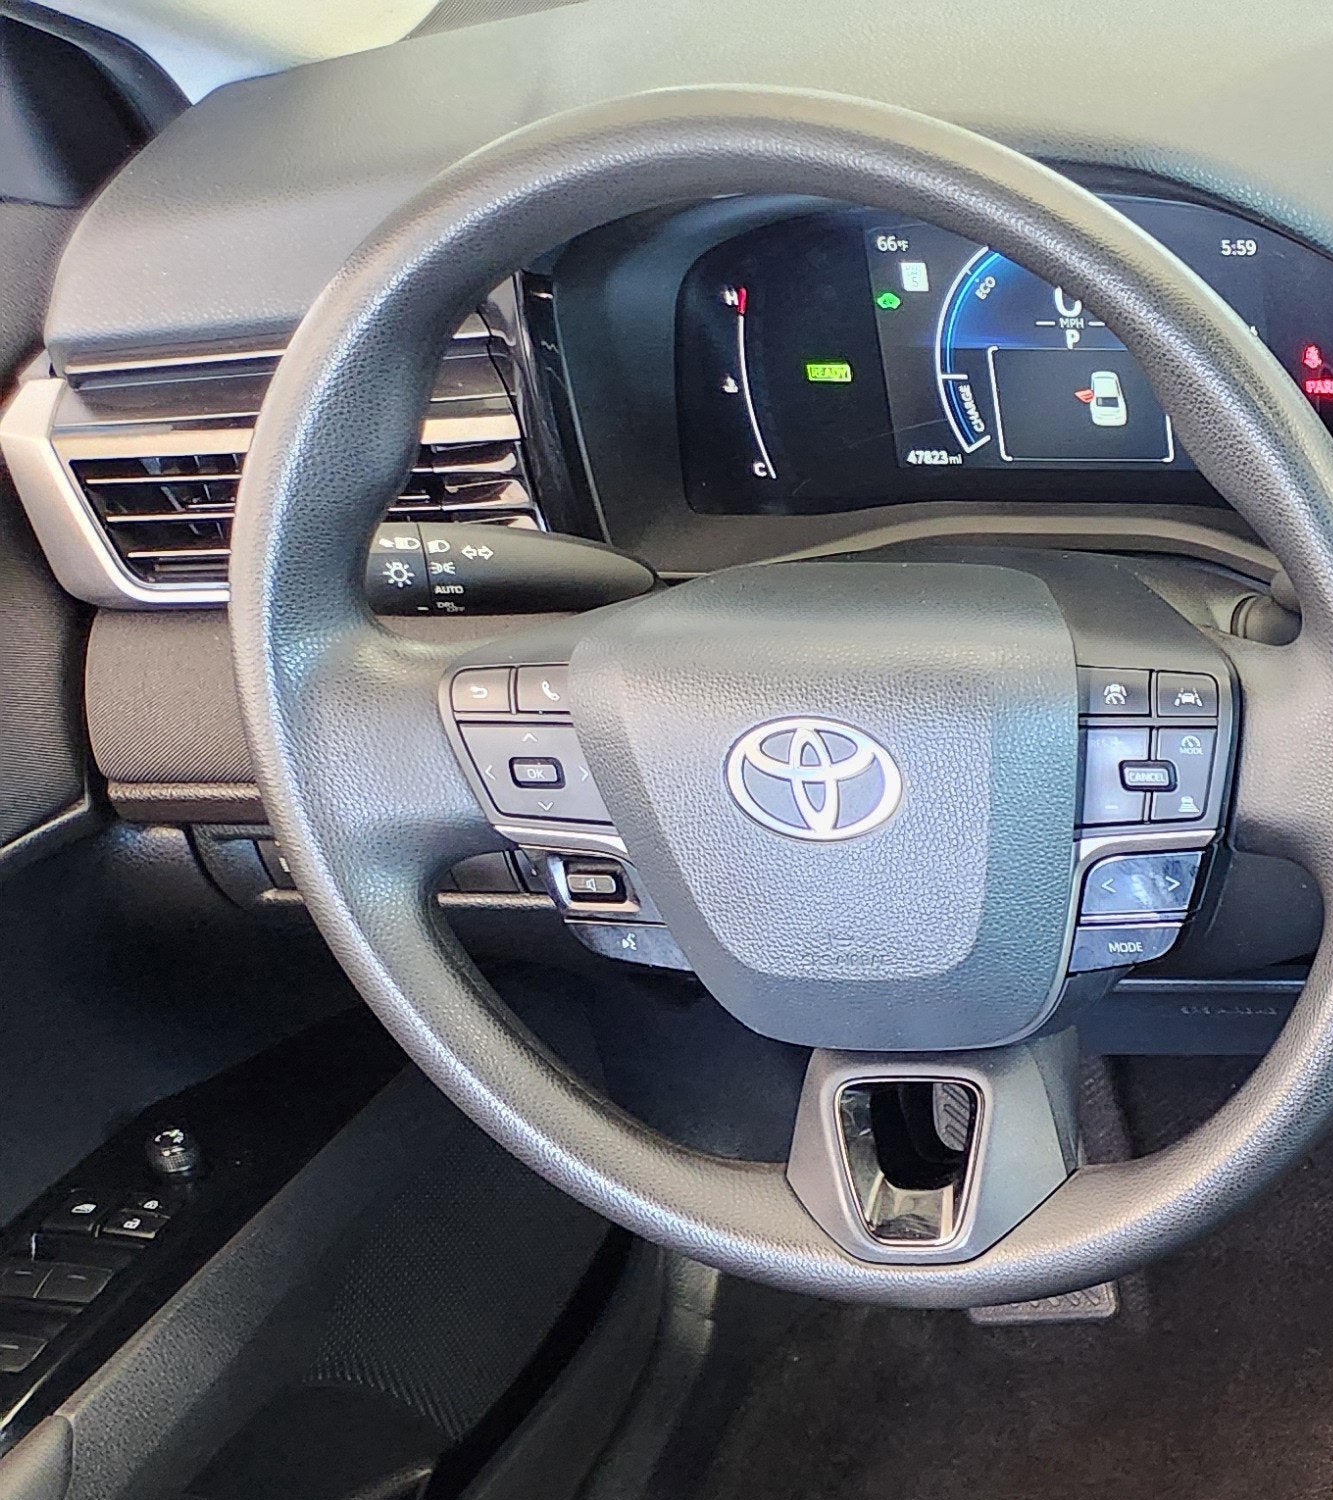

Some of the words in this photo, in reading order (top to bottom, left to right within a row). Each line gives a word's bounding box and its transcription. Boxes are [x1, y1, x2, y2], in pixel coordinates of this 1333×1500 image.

[1220, 239, 1257, 256] 5:59
[975, 276, 997, 300] ECO
[1059, 317, 1085, 329] MPH
[1066, 329, 1081, 349] P
[810, 366, 848, 379] READY
[958, 384, 985, 432] CHARGE
[906, 450, 948, 465] 47823
[753, 462, 767, 477] C
[434, 585, 464, 594] AUTO
[1180, 747, 1204, 755] MODE
[526, 768, 546, 781] OK
[1129, 772, 1166, 783] CANCEL
[1109, 941, 1143, 954] MODE
